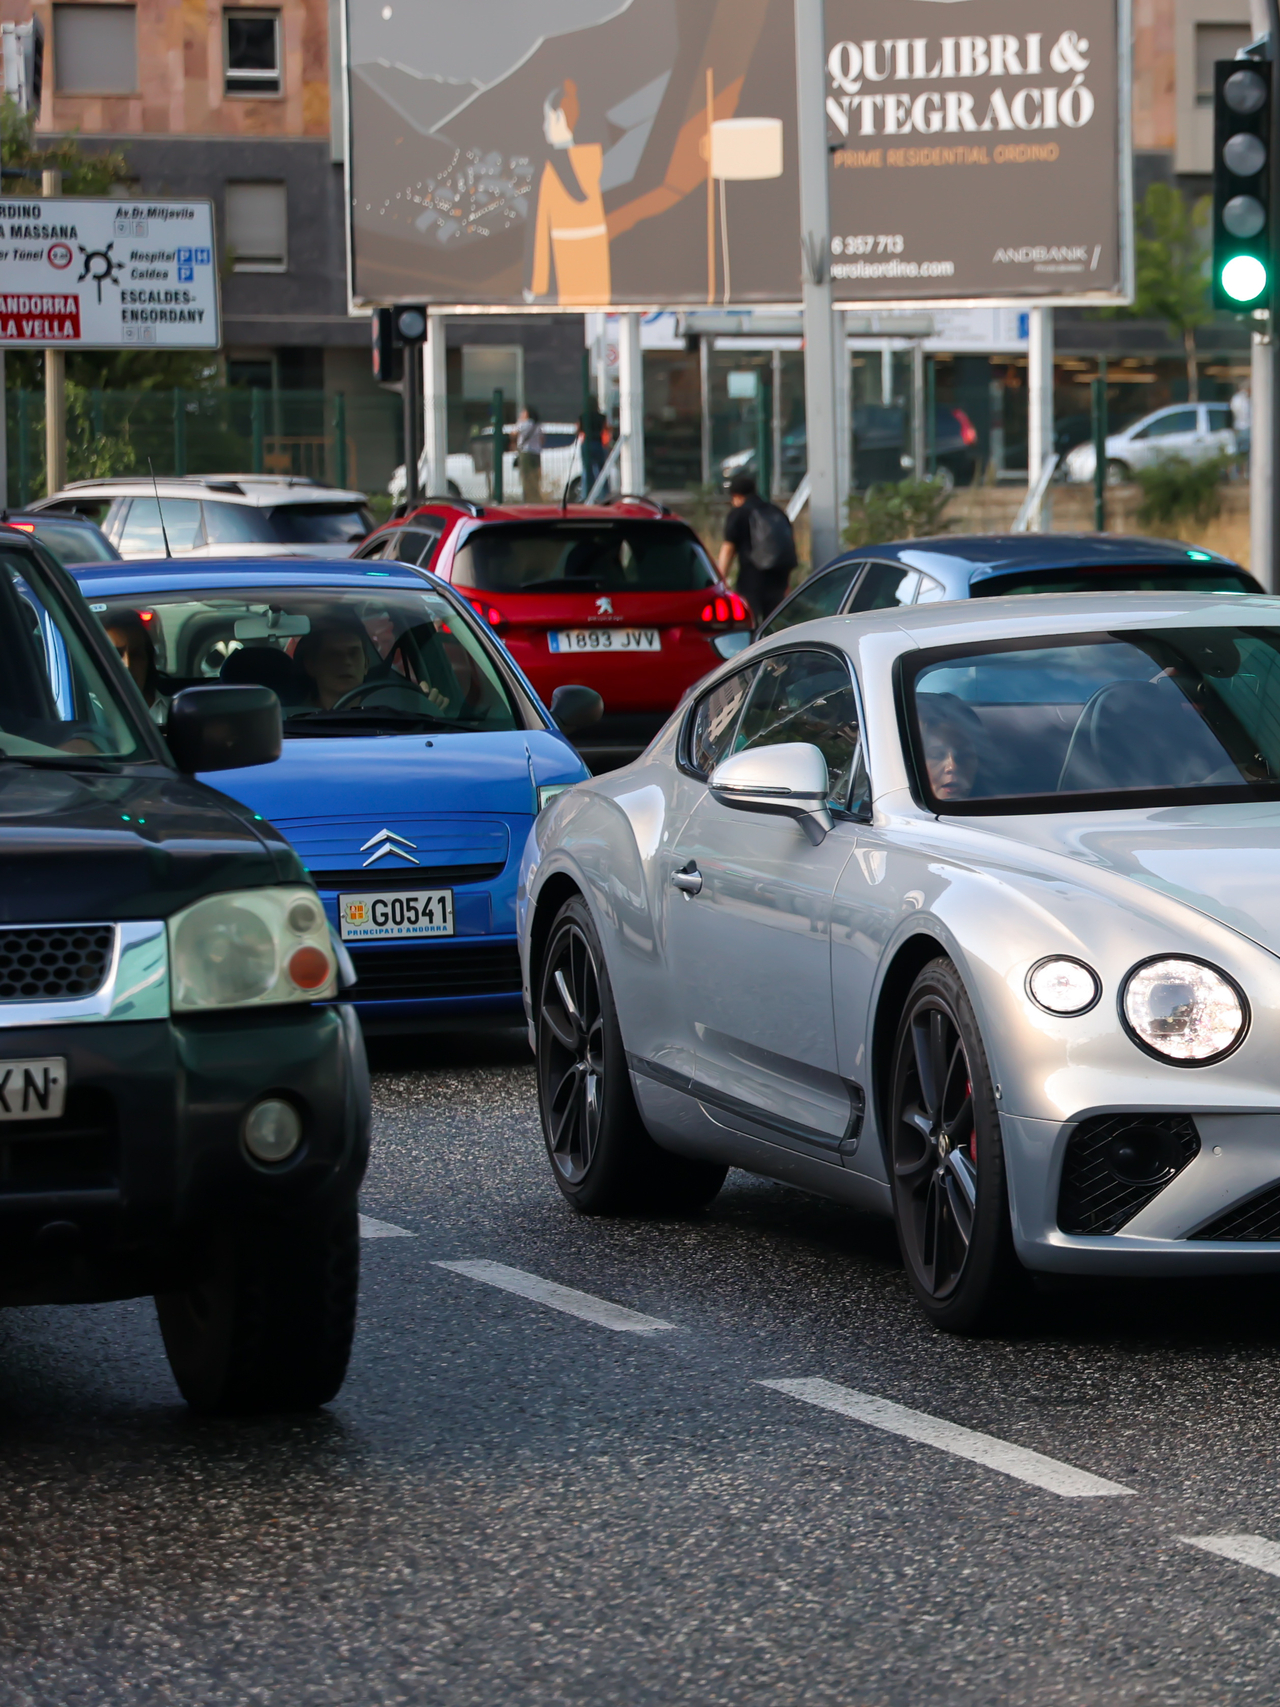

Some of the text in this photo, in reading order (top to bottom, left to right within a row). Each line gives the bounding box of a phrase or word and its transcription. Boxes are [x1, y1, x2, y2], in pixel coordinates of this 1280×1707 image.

[827, 30, 1090, 94] QUILIBRI &
[826, 73, 1095, 137] NTEGRACIÓ
[834, 142, 1060, 168] PRIME RESIDENTIAL ORDINO
[10, 224, 78, 240] MASSANA
[845, 235, 875, 255] 357
[876, 234, 904, 254] 713
[992, 245, 1088, 264] ANDBANK
[130, 249, 176, 264] Hospital
[0, 295, 77, 315] ANDORRA
[121, 307, 205, 324] ENGORDANY
[22, 318, 74, 338] VELLA
[565, 630, 654, 649] 1893 JVV
[371, 896, 447, 927] G0541
[347, 925, 448, 936] PRINCIPAT D'ANDORRA
